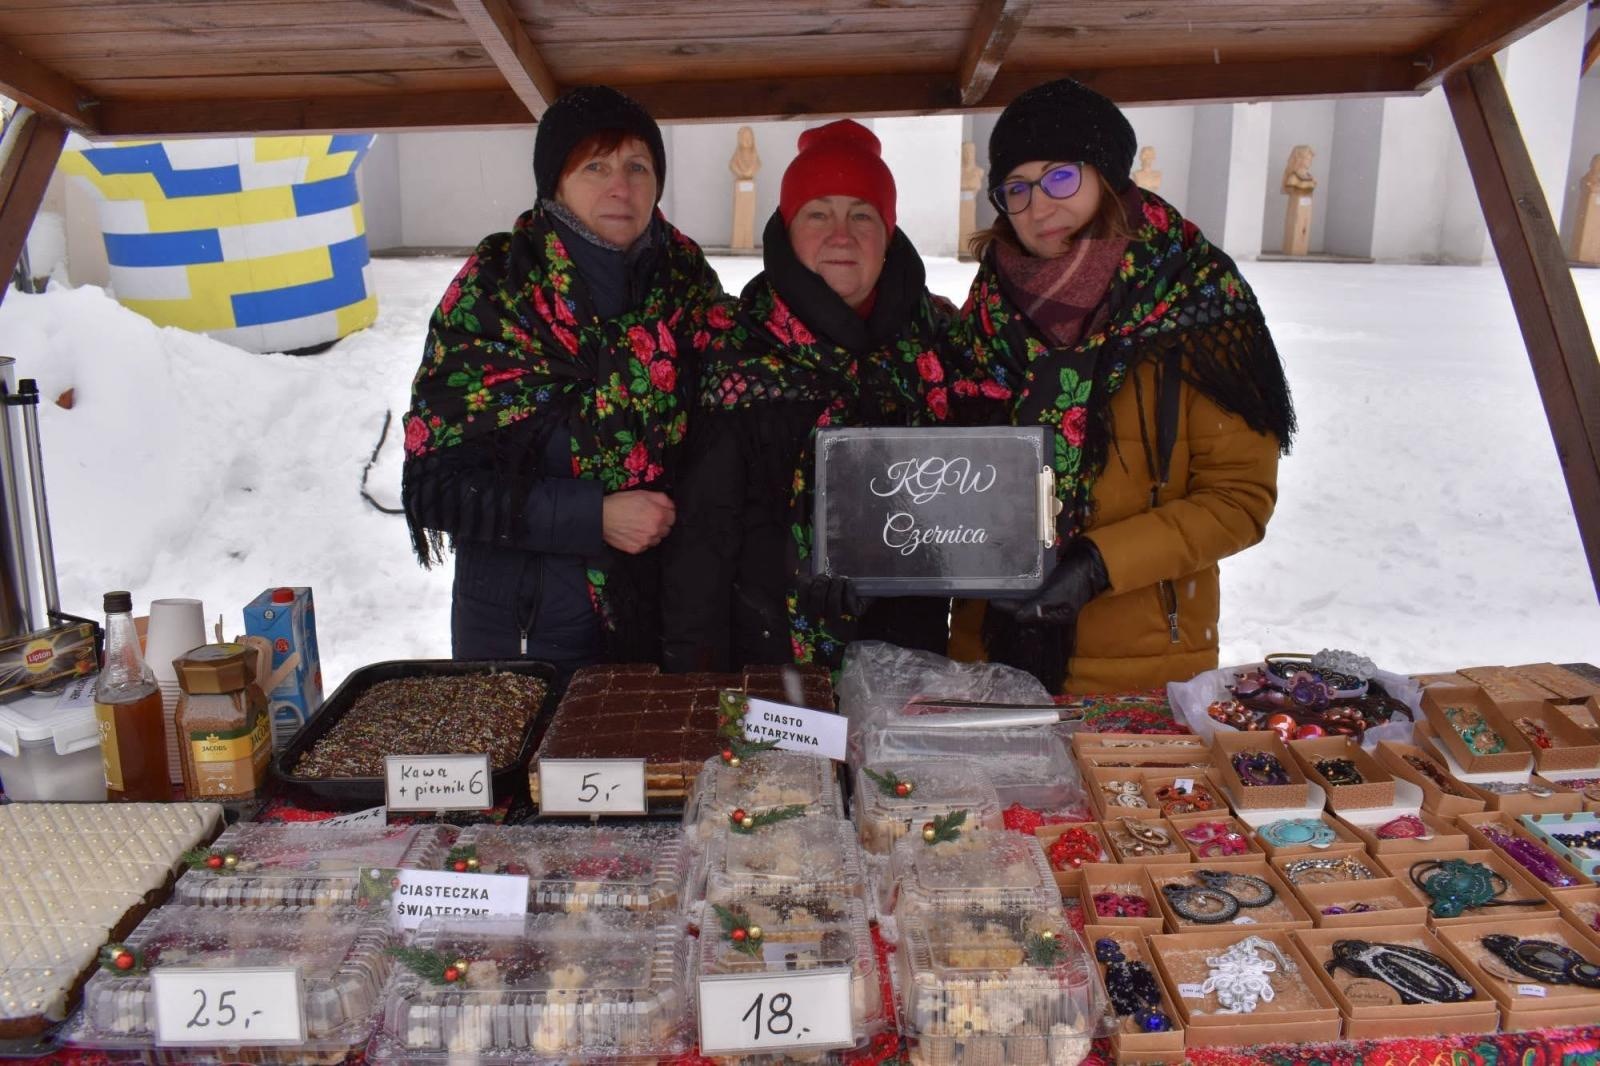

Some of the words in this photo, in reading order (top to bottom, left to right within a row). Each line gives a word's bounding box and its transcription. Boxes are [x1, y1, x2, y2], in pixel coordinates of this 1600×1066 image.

[870, 456, 997, 504] KGW
[882, 512, 989, 556] Czernica
[28, 649, 52, 662] Lipton
[763, 712, 803, 728] CIASTO
[745, 723, 819, 746] KATARZYNKA
[401, 764, 448, 781] Kawa
[415, 780, 465, 801] piernik
[469, 769, 483, 795] 6
[400, 884, 489, 900] CIASTECZKA
